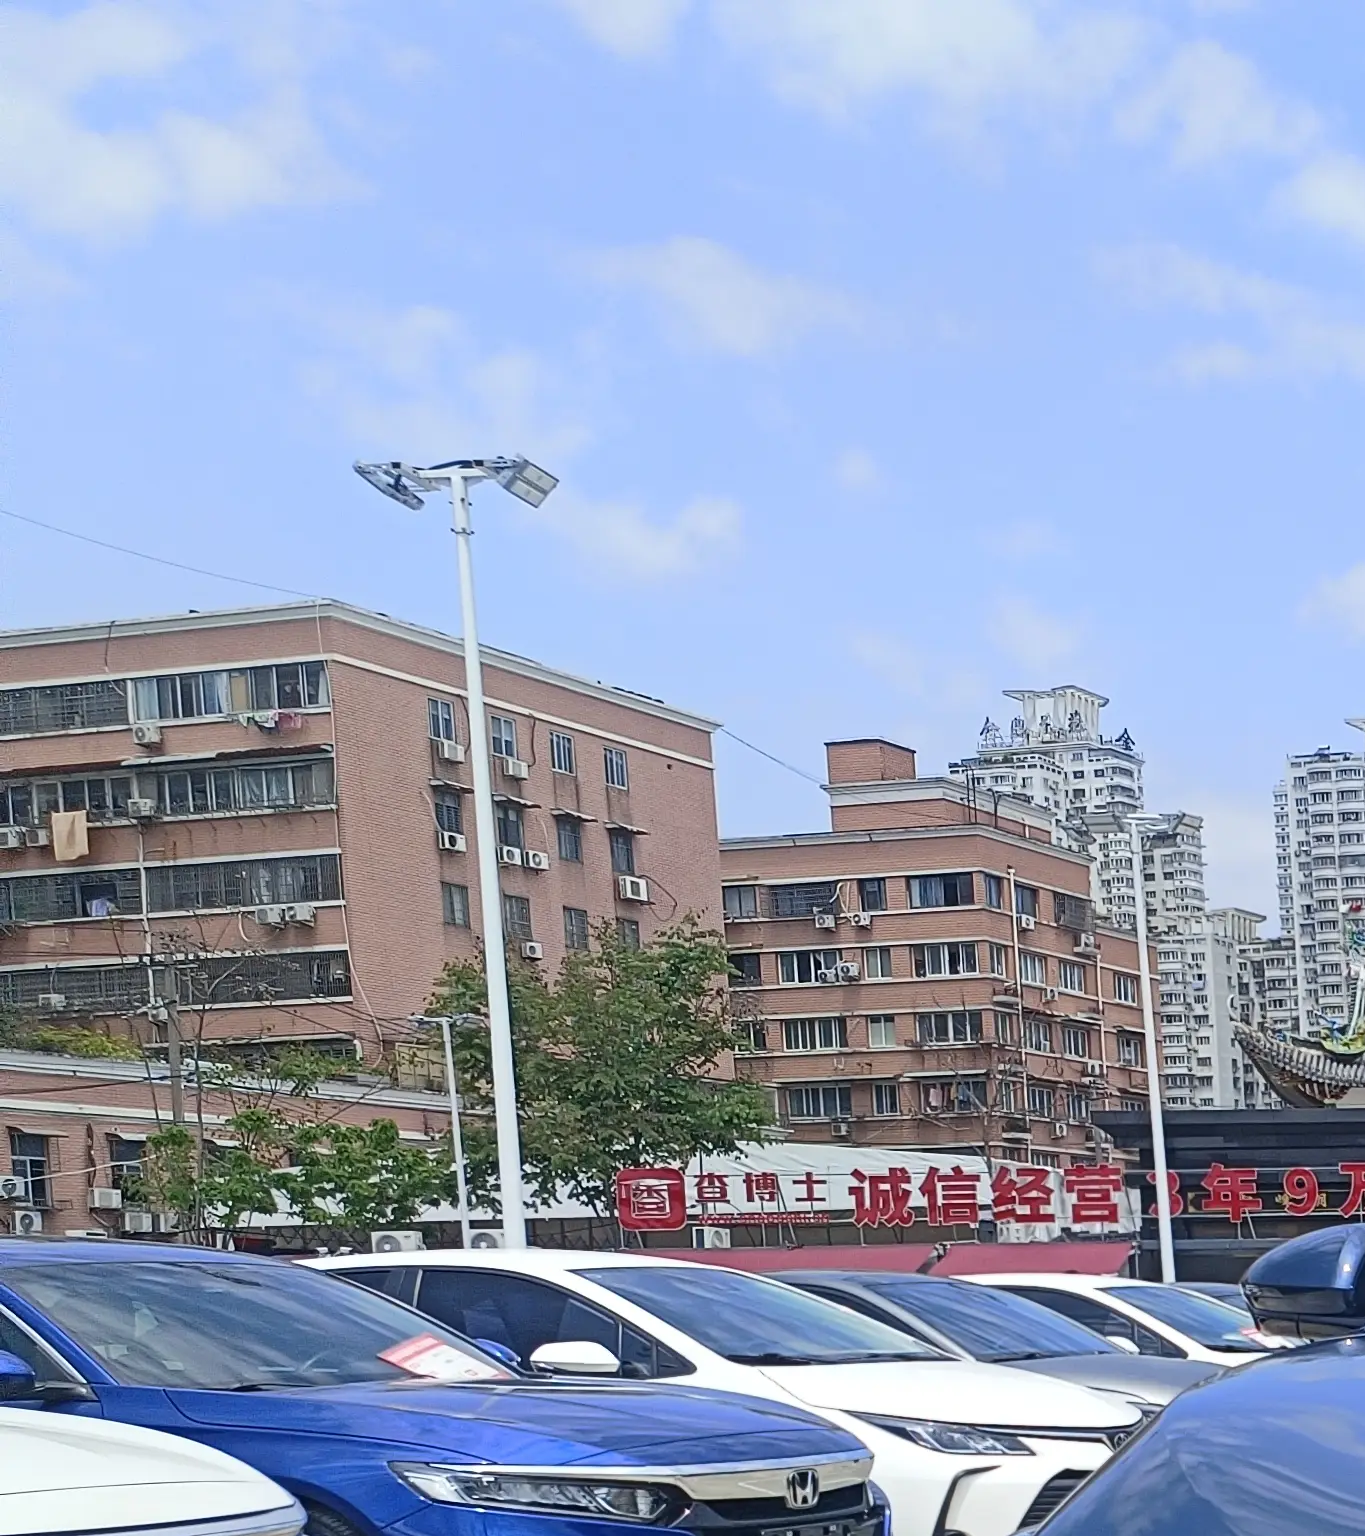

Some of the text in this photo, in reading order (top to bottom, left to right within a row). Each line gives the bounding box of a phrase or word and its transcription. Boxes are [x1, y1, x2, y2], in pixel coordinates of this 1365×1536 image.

[694, 1171, 829, 1205] 查博士
[848, 1163, 1125, 1229] 诚信经营
